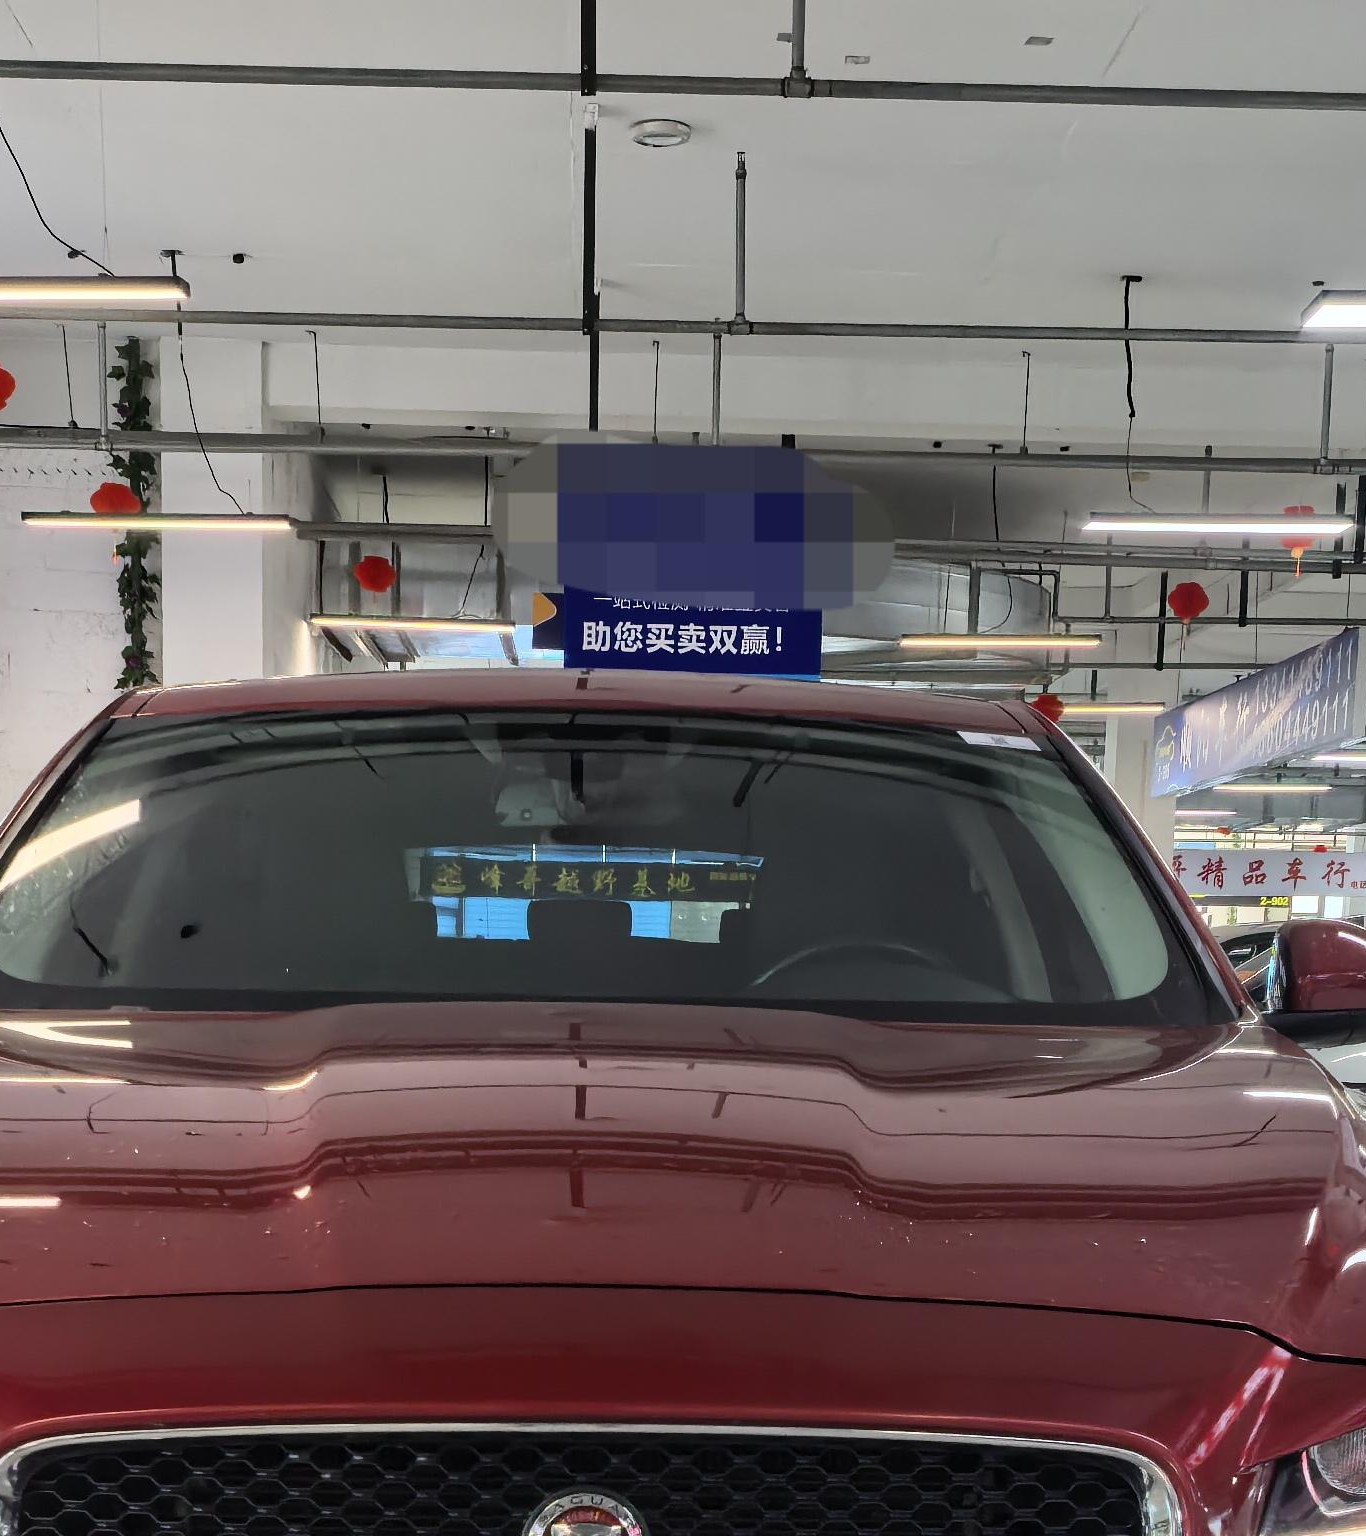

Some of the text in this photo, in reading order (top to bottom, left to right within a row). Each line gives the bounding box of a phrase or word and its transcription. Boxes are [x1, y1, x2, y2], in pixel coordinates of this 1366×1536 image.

[581, 620, 783, 655] 助您买卖双赢!
[1259, 896, 1289, 907] 2-902
